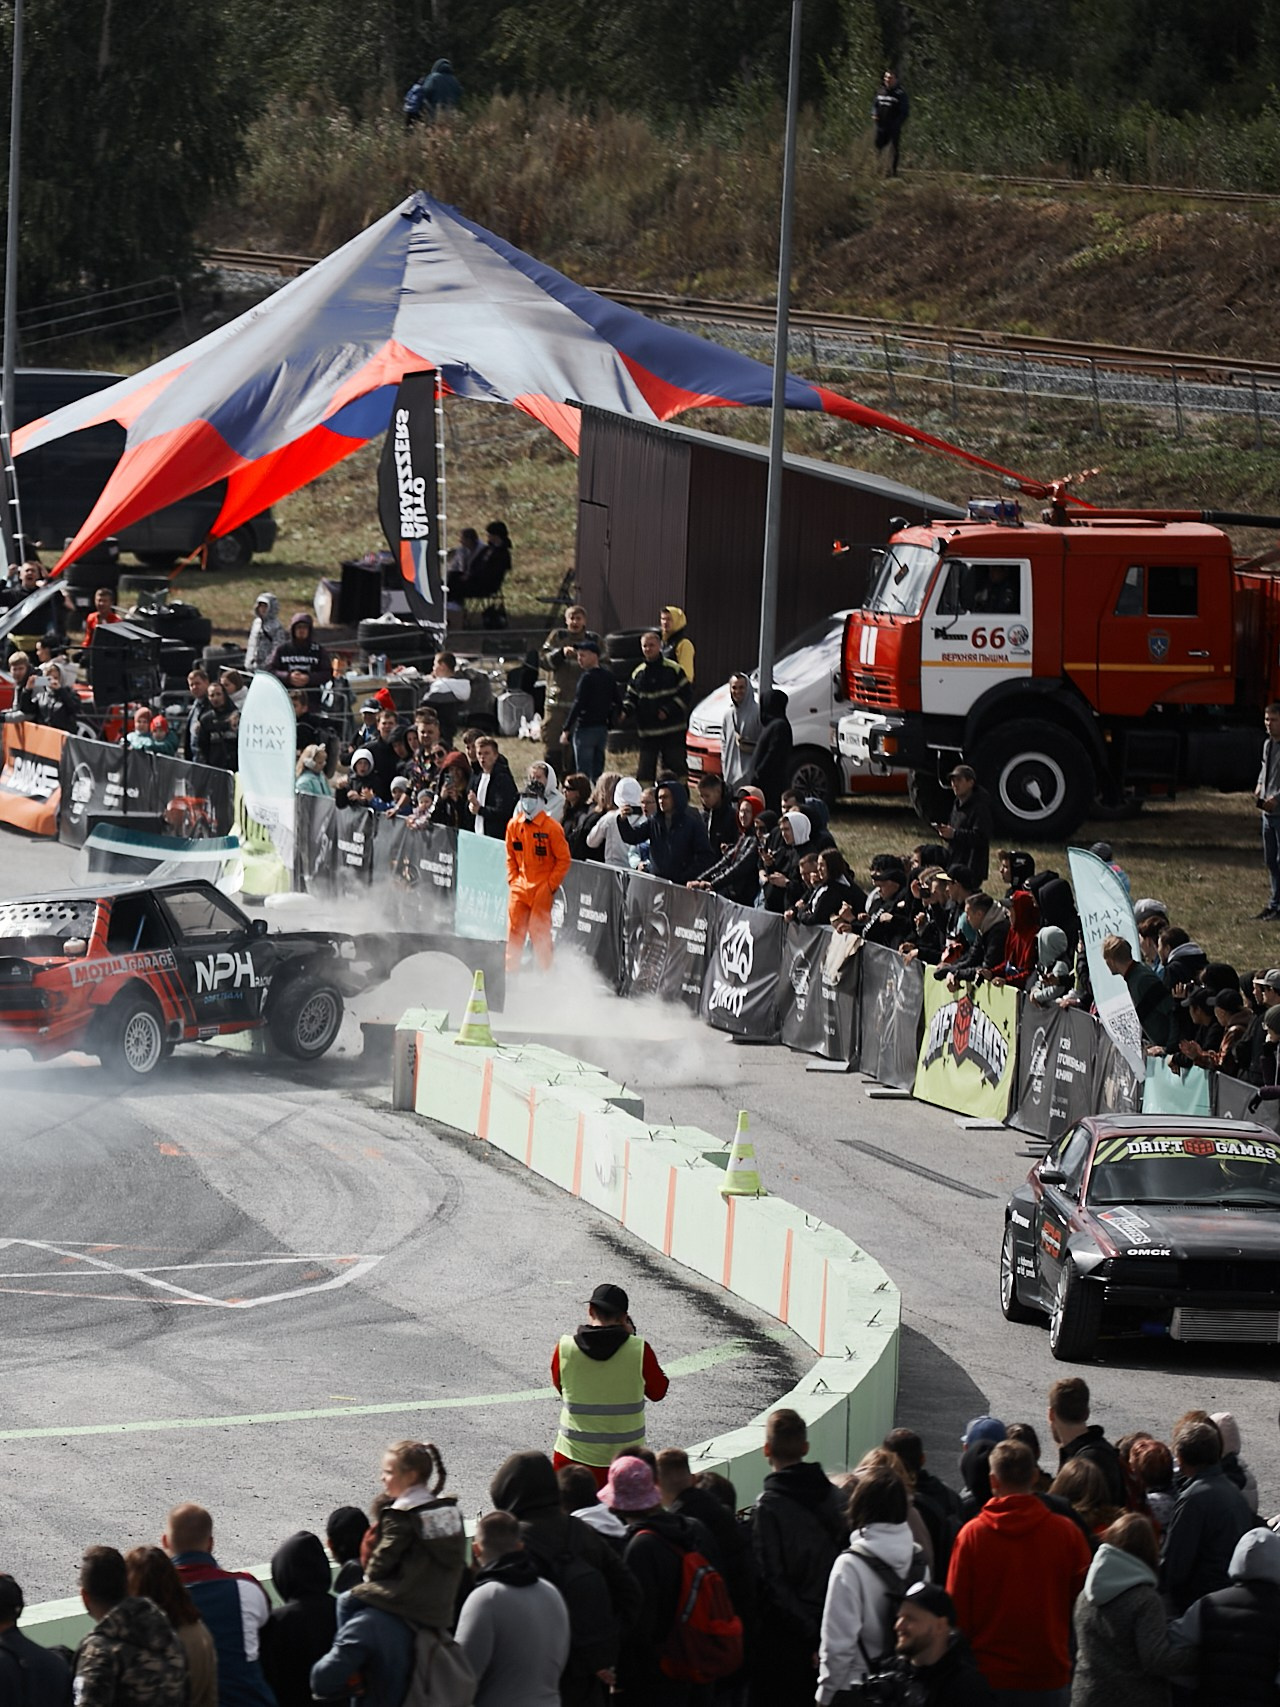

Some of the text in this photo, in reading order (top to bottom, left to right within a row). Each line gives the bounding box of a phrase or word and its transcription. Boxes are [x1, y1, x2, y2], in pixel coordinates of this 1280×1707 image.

[971, 627, 1006, 649] 66
[280, 655, 319, 665] SECURITY
[941, 652, 1010, 663] ВЕРХНЯЯ ПЫШМА
[128, 953, 174, 971] GARAGE
[195, 951, 256, 993] NPH
[1127, 1139, 1278, 1160] DRIFT GAMES
